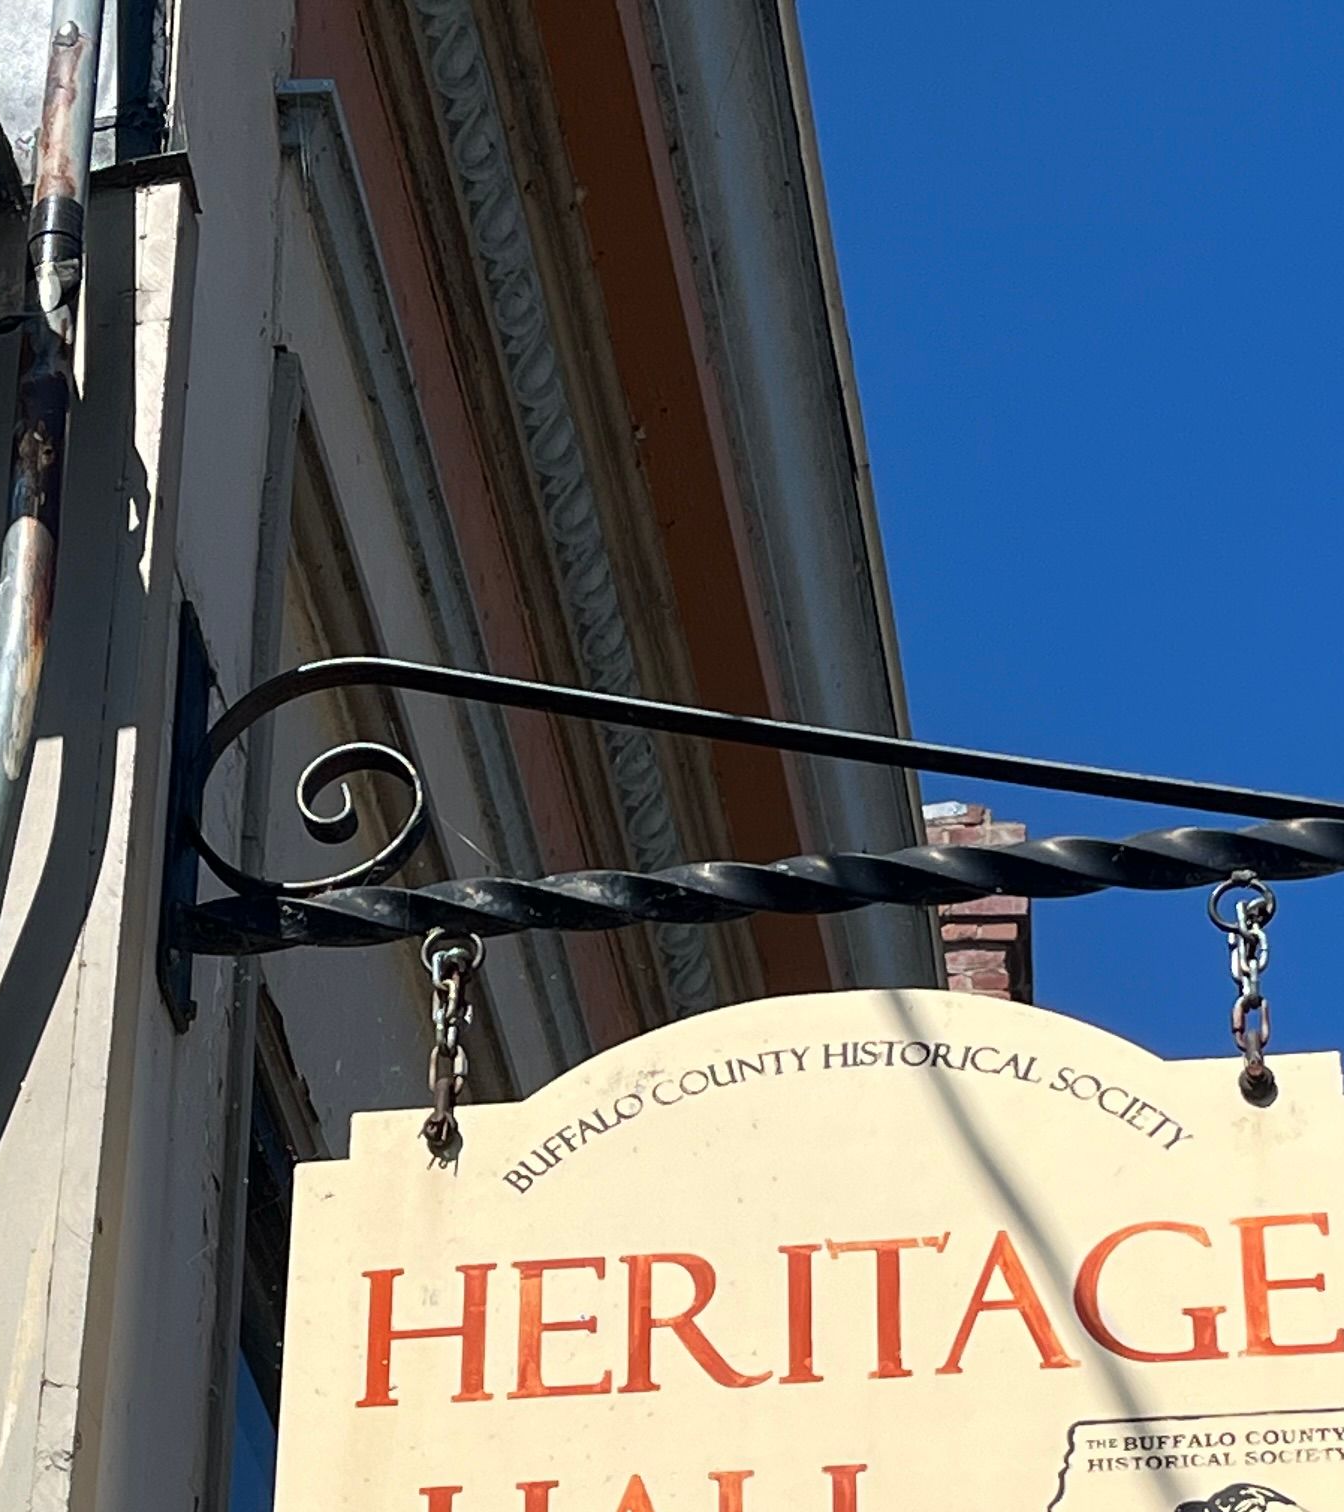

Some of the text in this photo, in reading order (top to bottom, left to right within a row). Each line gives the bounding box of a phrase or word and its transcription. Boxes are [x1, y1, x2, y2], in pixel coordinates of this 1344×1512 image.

[502, 1040, 1195, 1194] BUFFALO COUNTY HISTORICAL SOCIETY
[1086, 1438, 1119, 1451] THE
[1122, 1431, 1237, 1452] BUFFALO
[1086, 1451, 1237, 1474] HISTORICAL
